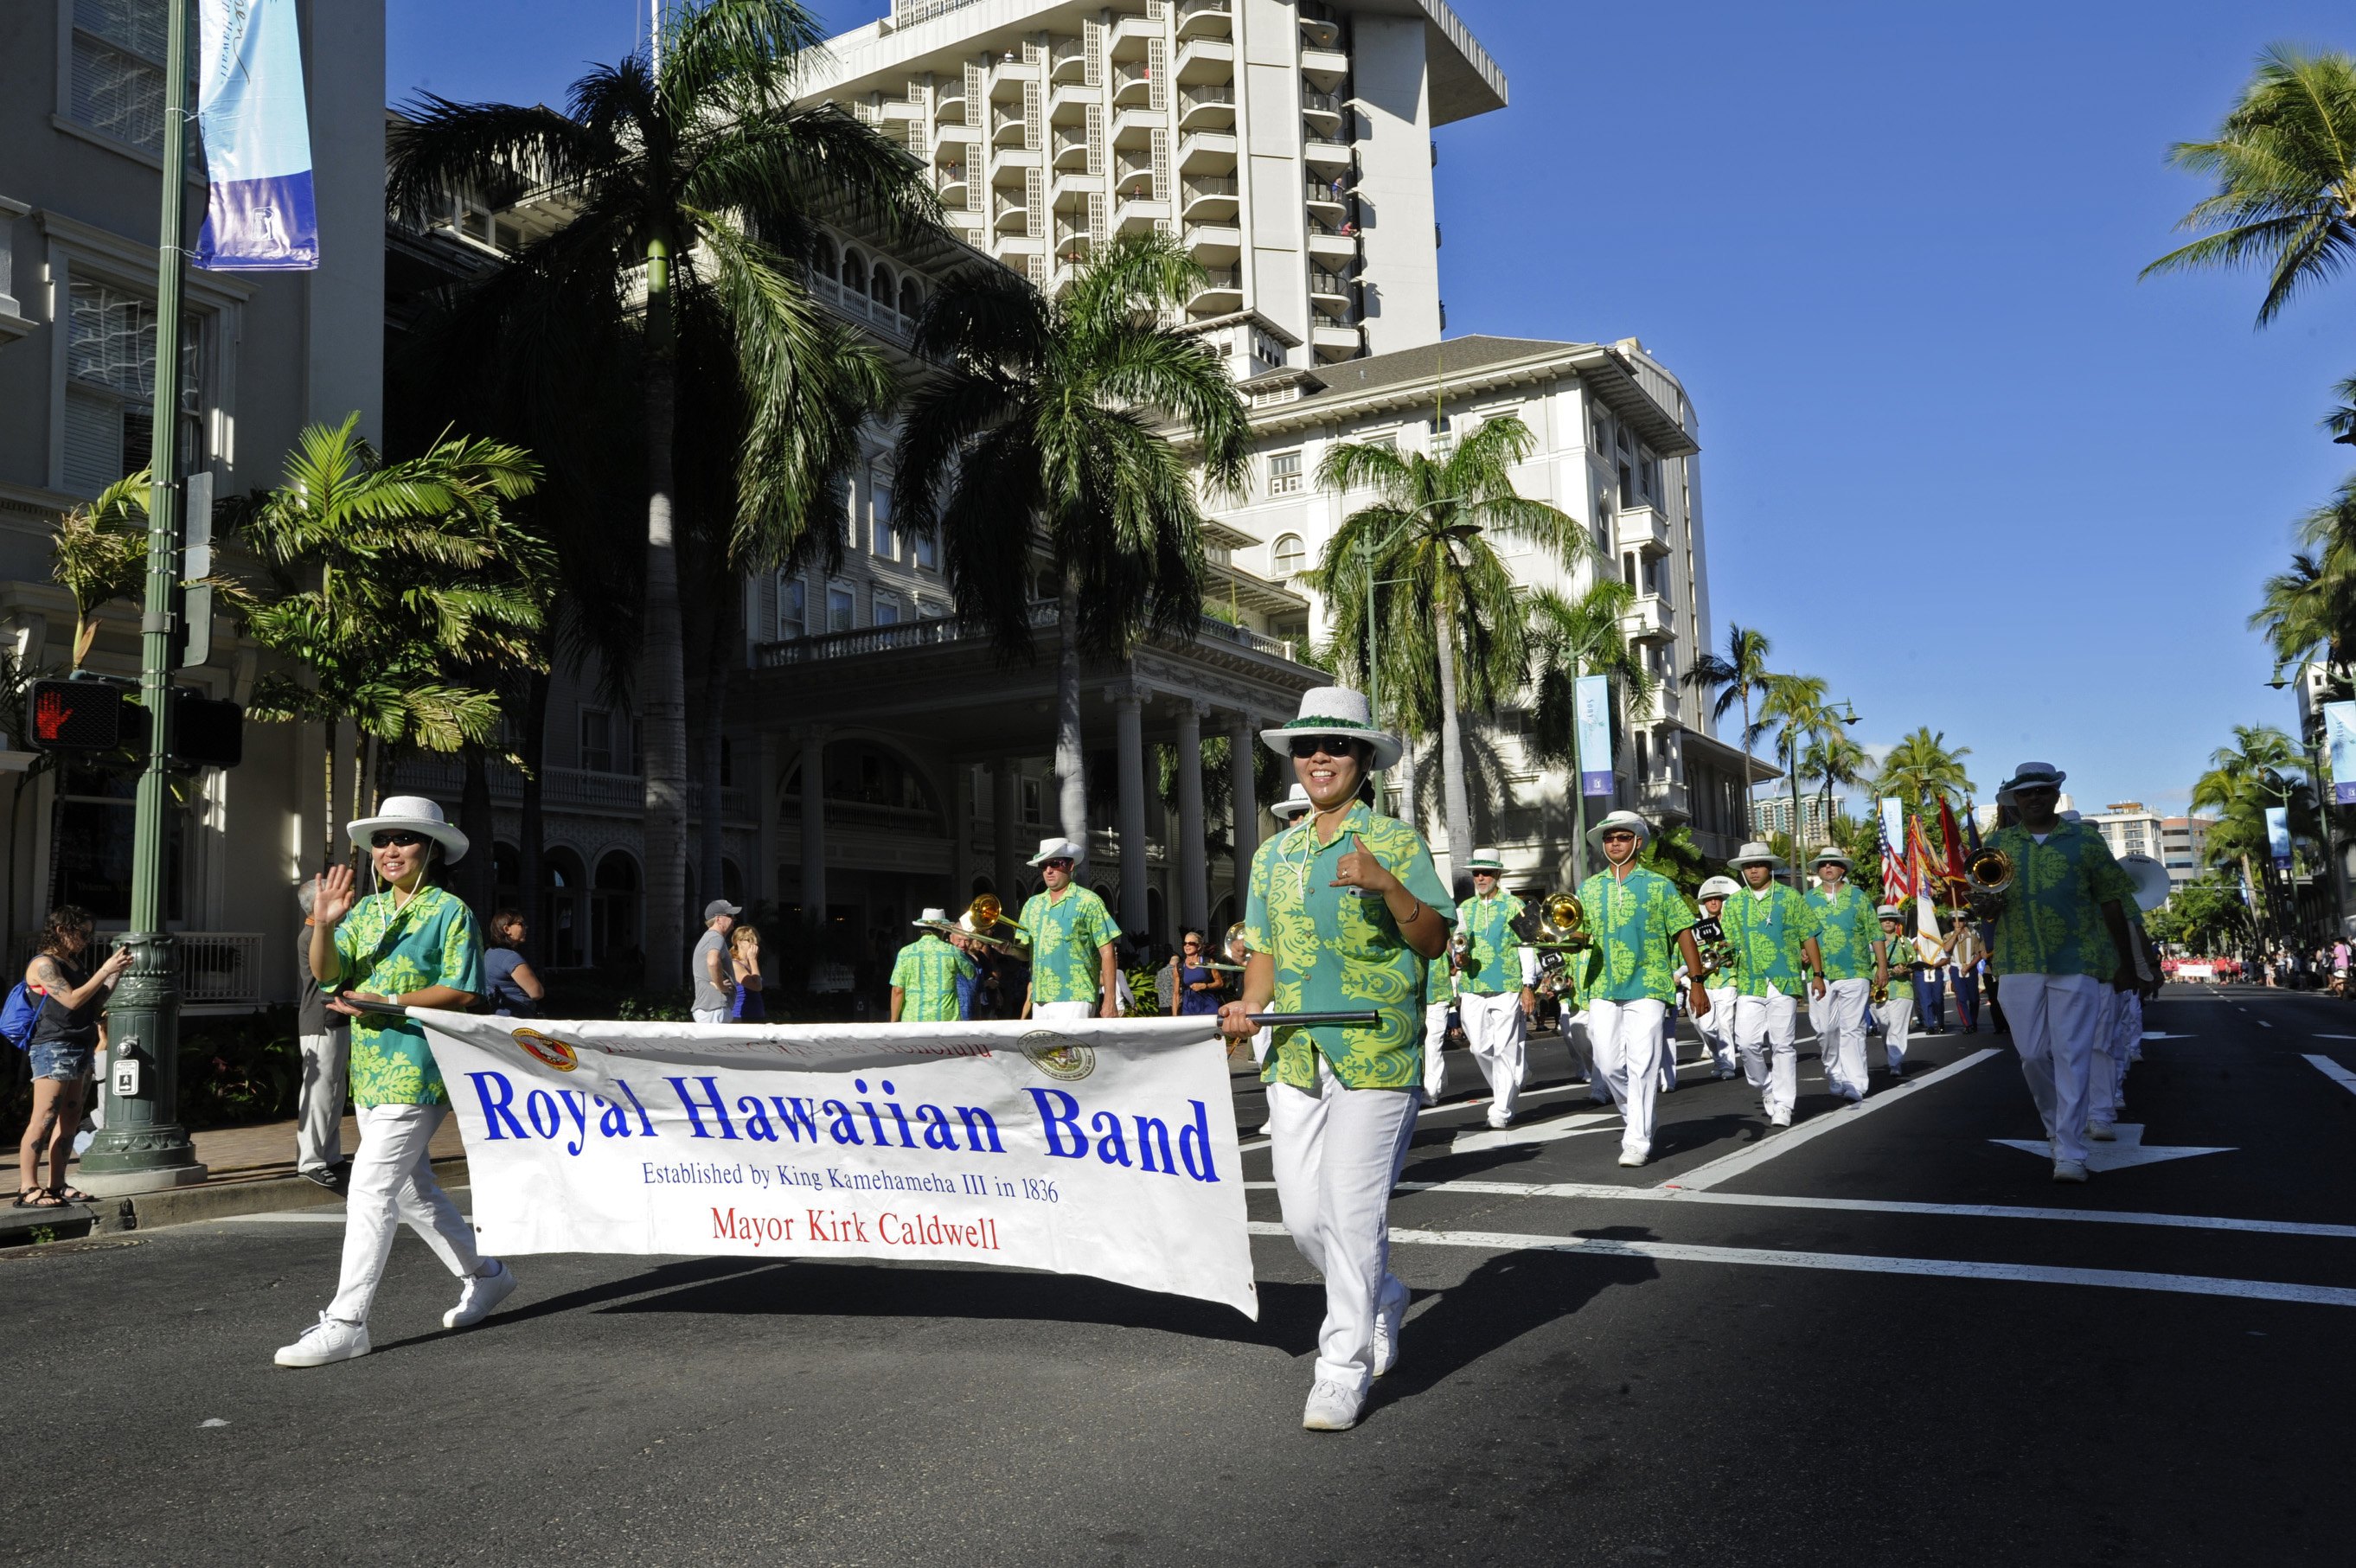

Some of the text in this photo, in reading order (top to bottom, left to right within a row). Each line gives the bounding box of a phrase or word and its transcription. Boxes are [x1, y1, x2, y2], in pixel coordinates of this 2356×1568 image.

[869, 1040, 992, 1058] Honolulu
[464, 1071, 1220, 1183] Royal Hawaiian Band
[643, 1162, 1059, 1204] Established by King Kamehameha III in 1836
[711, 1207, 1001, 1251] Mayor Kirk Caldwell
